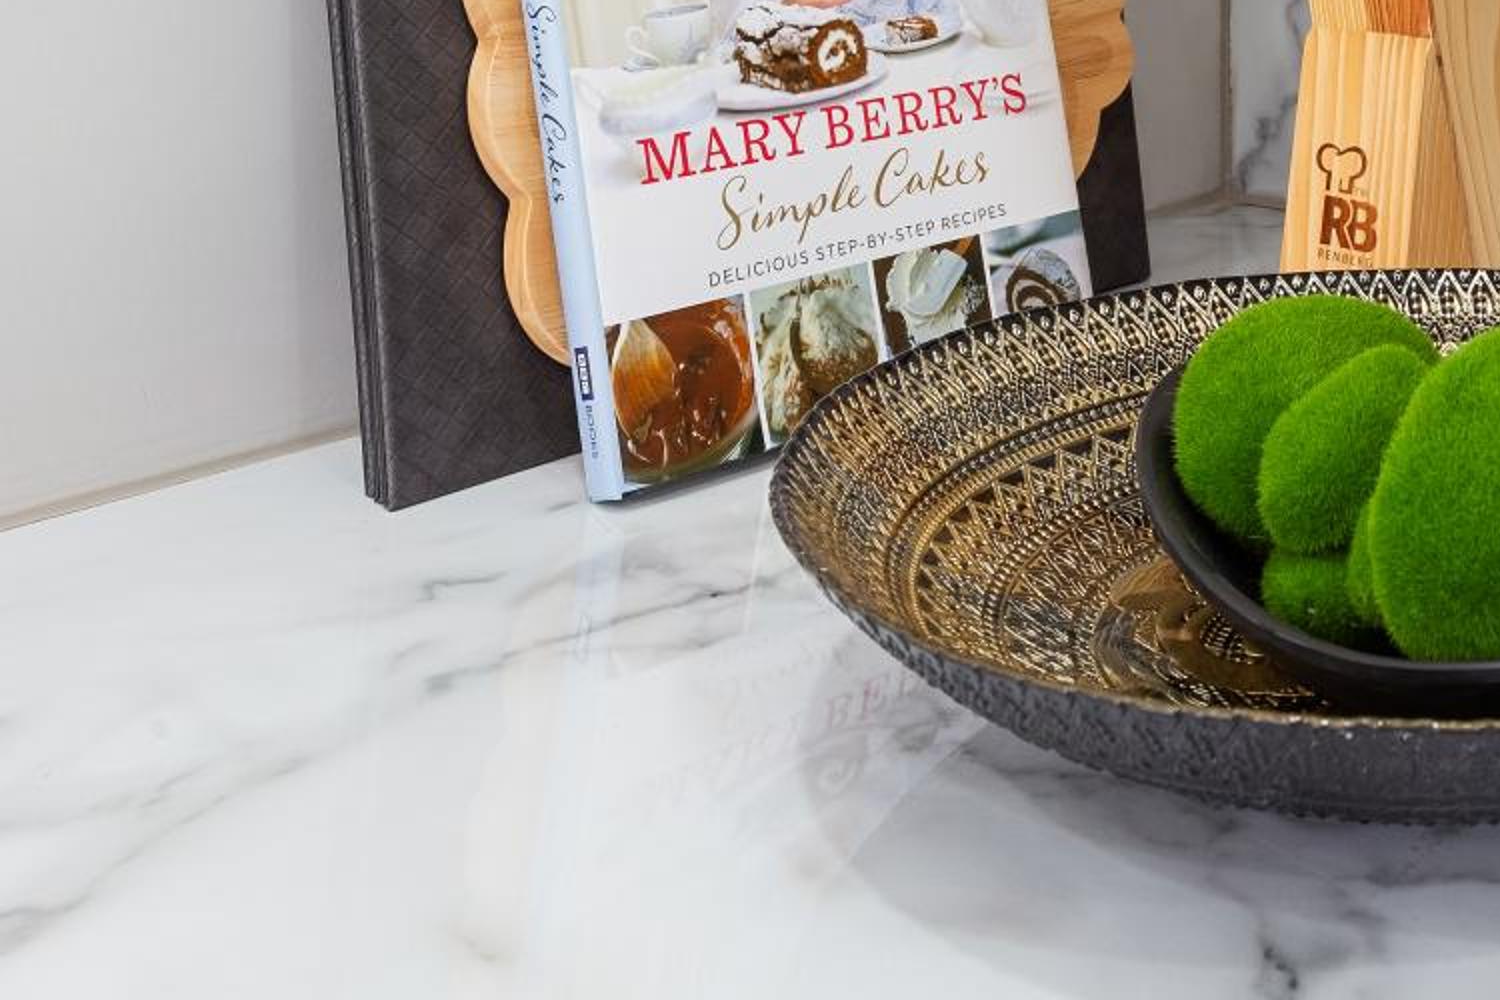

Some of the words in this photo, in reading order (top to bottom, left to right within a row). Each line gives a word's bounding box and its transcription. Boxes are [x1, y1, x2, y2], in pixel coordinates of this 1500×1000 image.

[526, 4, 559, 104] Simple
[541, 113, 567, 204] Cakes
[636, 110, 807, 185] MARY
[820, 72, 1027, 150] BERRY'S
[708, 251, 810, 287] DELICIOUS
[815, 225, 936, 261] STEP-BY-STEP
[941, 203, 1008, 230] RECIPES
[717, 163, 865, 251] Simple
[874, 146, 991, 209] Cakes
[1320, 195, 1377, 252] RB
